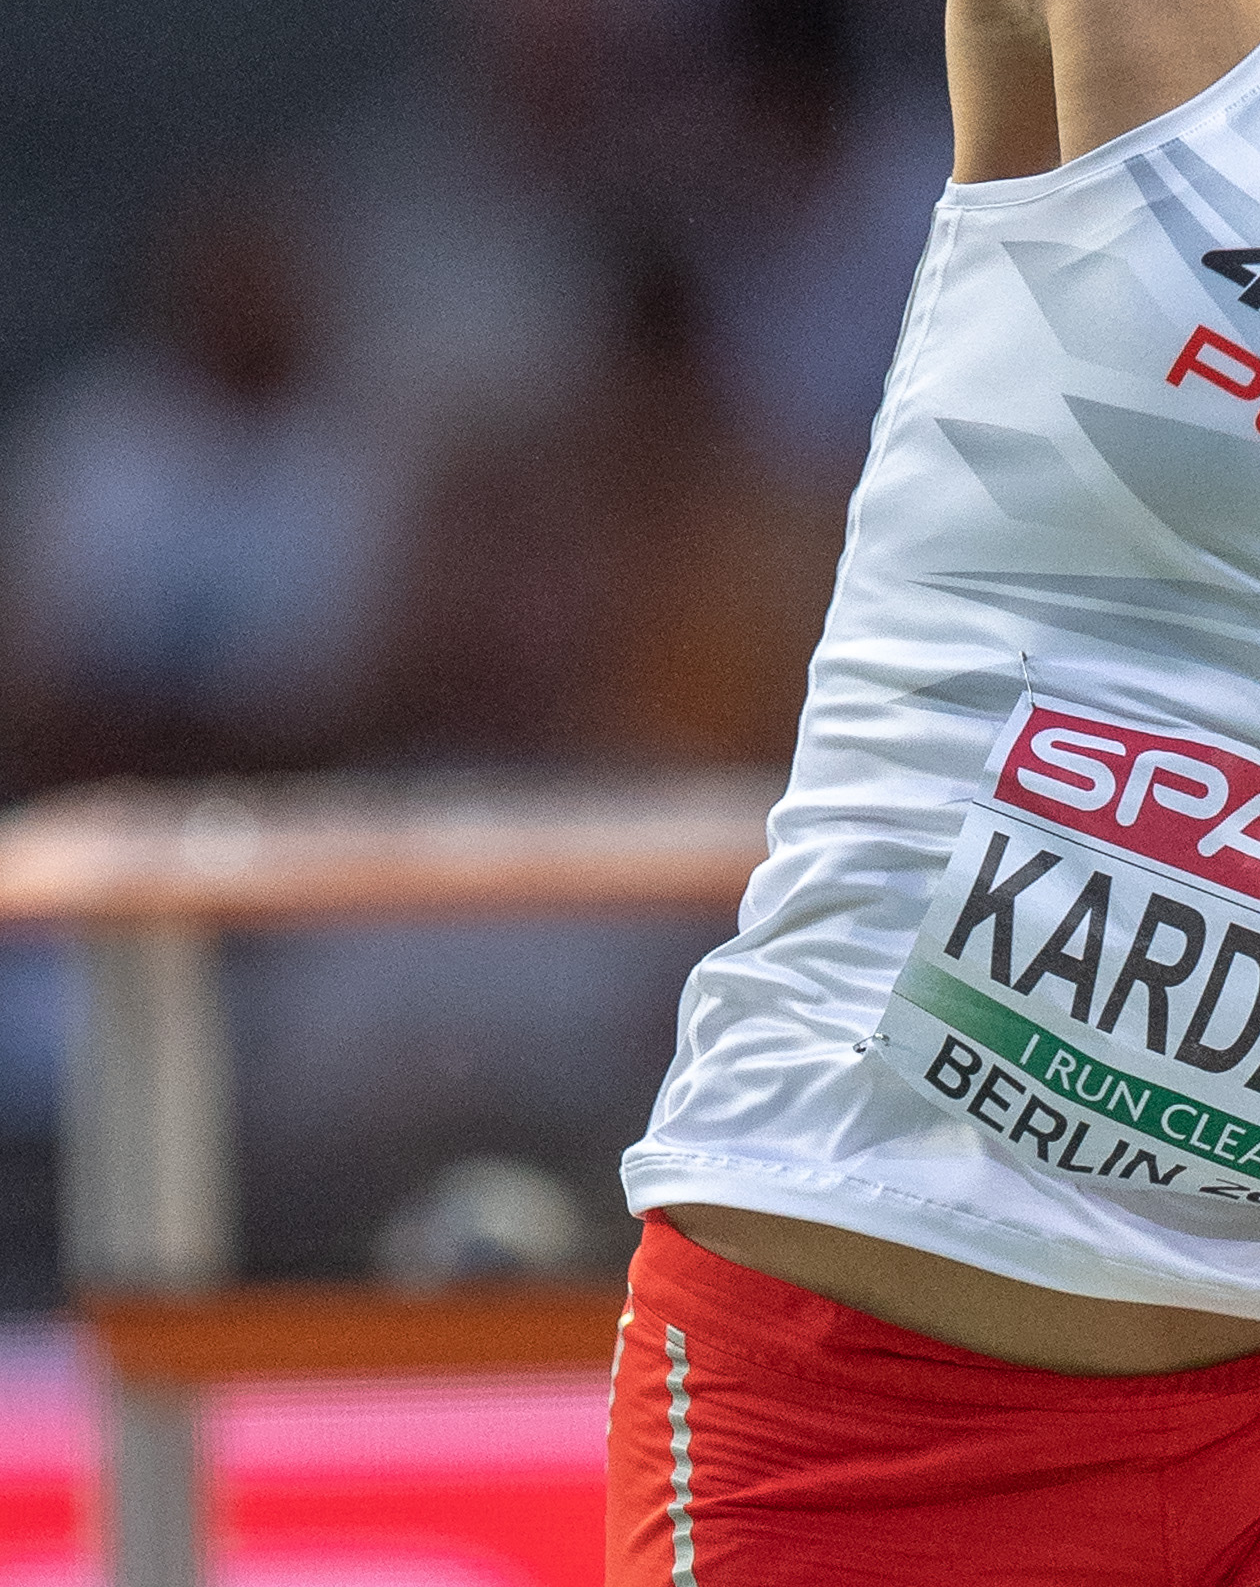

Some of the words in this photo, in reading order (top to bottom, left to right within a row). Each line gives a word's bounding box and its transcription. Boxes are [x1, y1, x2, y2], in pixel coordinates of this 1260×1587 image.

[924, 1034, 1187, 1186] BERLIN
[1019, 1034, 1040, 1065] I
[1044, 1049, 1151, 1122] RUN
